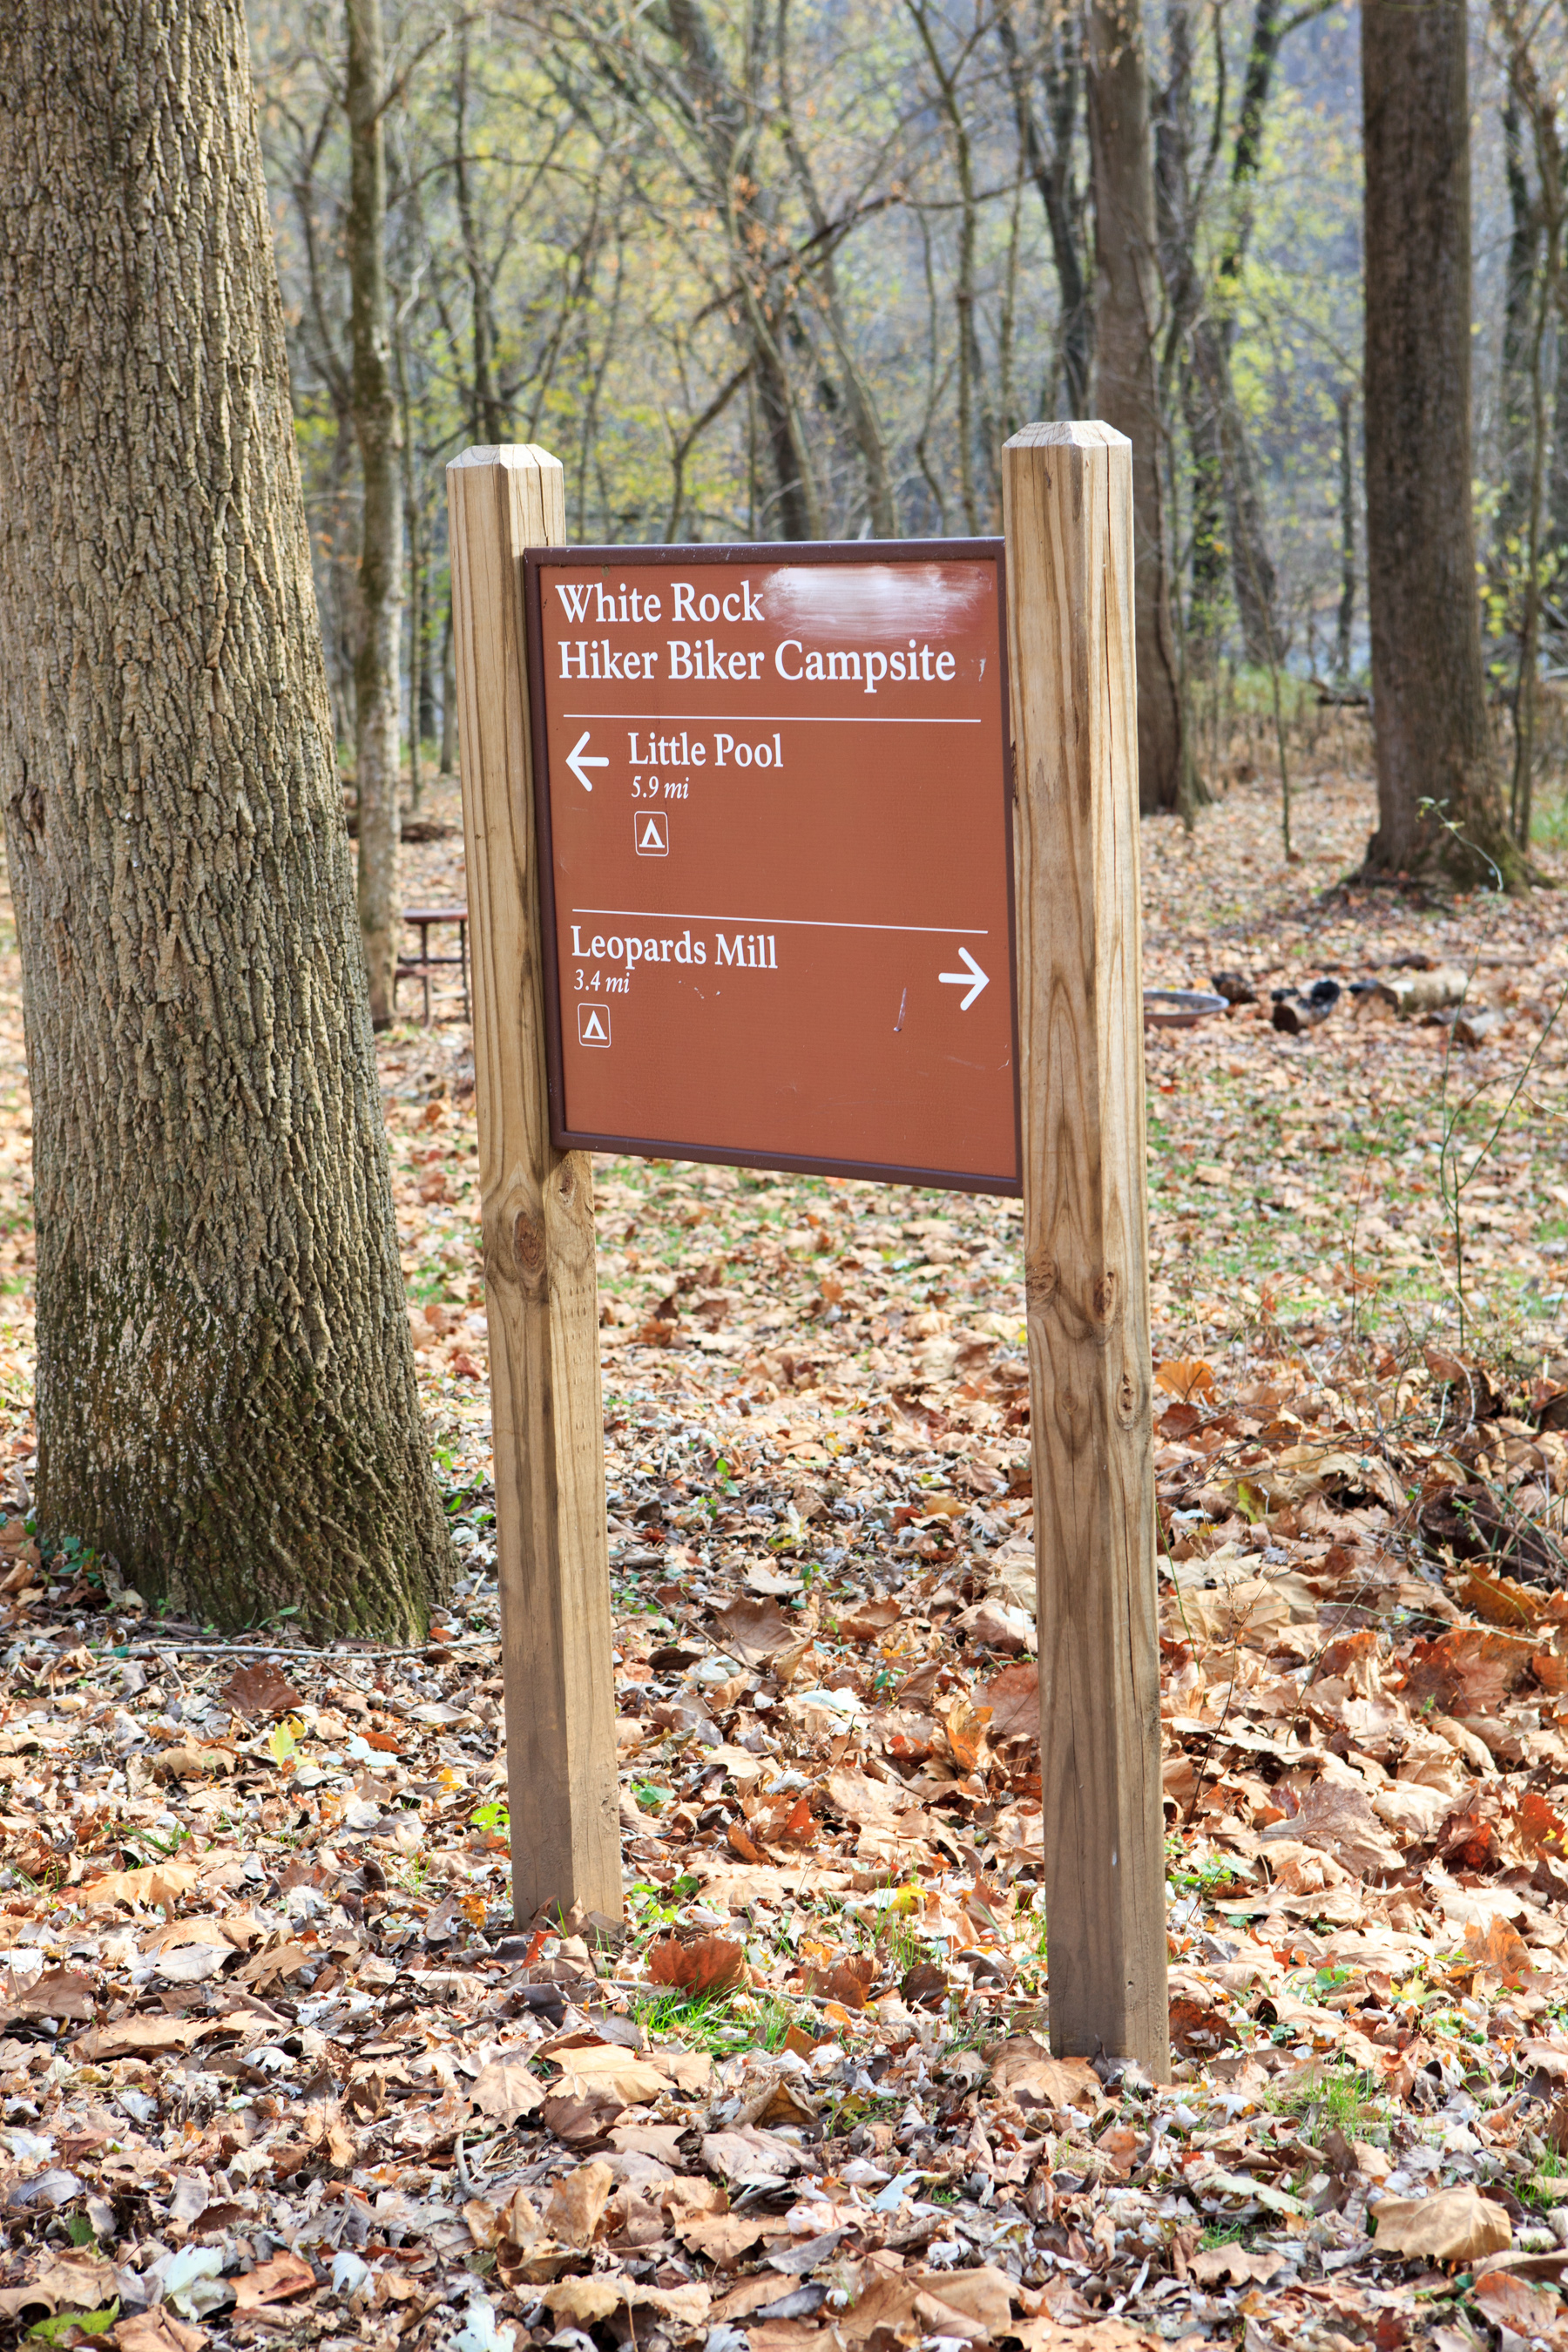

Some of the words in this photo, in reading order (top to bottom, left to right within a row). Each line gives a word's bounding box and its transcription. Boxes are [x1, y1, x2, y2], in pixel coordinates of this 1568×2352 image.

[555, 583, 661, 623] White
[671, 580, 765, 622] Rock
[558, 639, 658, 679] Hiker
[667, 639, 765, 679] Biker
[775, 637, 956, 693] Campsite
[628, 732, 706, 766] Little
[713, 733, 783, 767] Pool
[632, 776, 659, 798] 5.9
[664, 777, 689, 799] mi
[571, 925, 706, 970] Leopards
[715, 934, 778, 969] Mill
[574, 969, 600, 991] 3.4
[605, 972, 630, 993] mi
